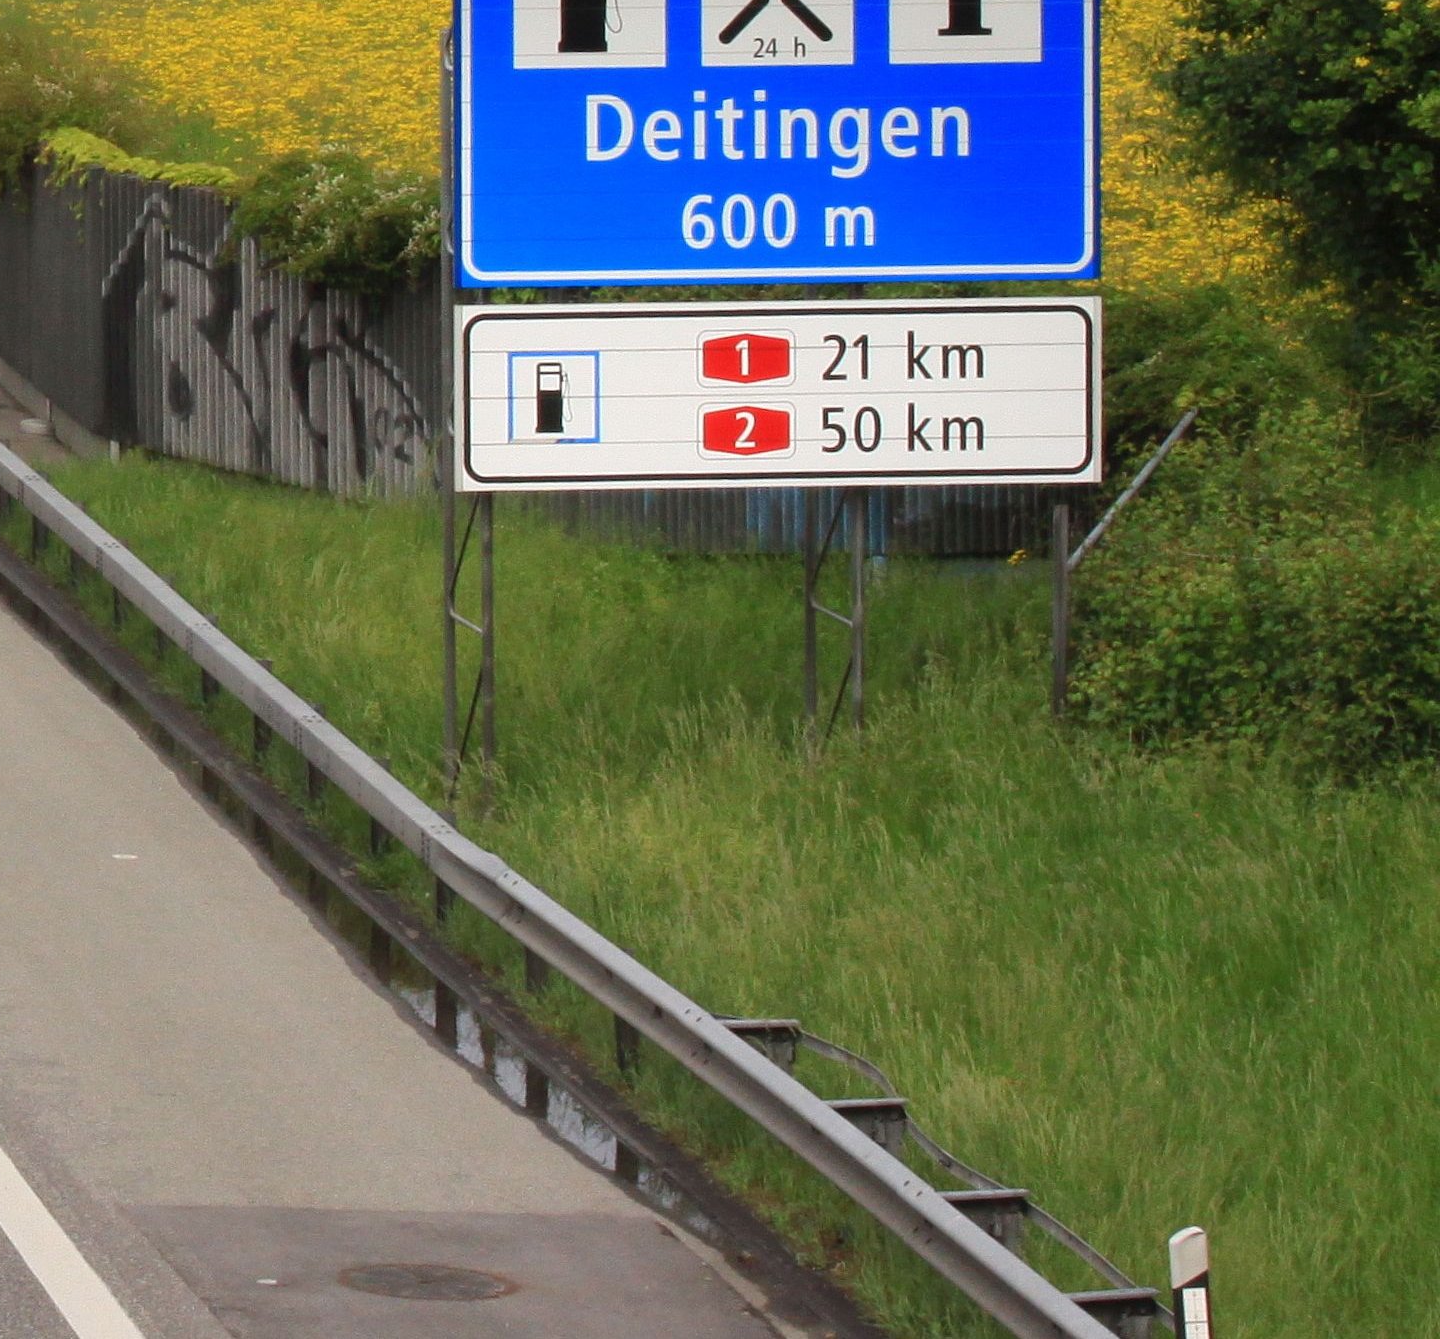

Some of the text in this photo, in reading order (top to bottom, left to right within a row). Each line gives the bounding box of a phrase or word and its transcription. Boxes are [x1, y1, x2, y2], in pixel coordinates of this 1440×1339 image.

[753, 36, 806, 58] 24 h
[584, 89, 970, 178] Deitingen
[681, 193, 876, 250] 600 m
[736, 330, 985, 381] 1 21 km
[734, 403, 985, 453] 2 50 km
